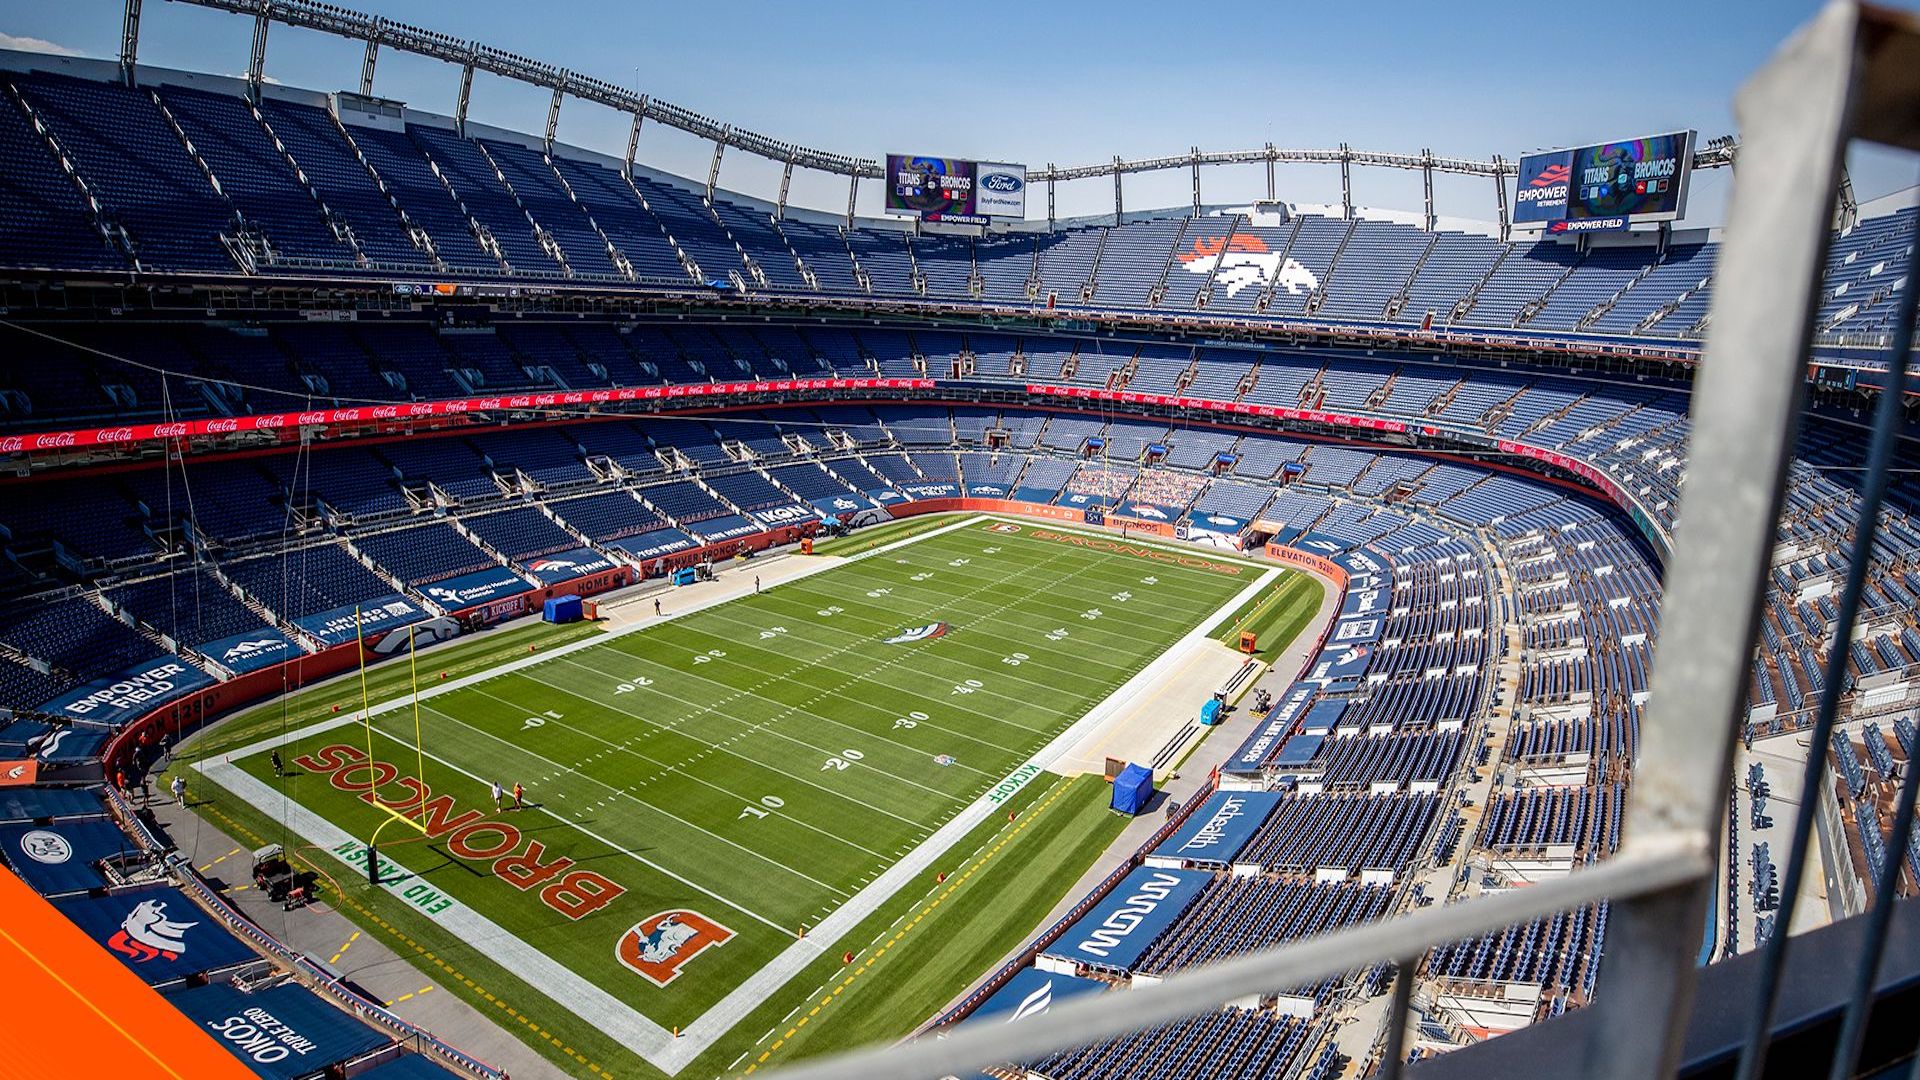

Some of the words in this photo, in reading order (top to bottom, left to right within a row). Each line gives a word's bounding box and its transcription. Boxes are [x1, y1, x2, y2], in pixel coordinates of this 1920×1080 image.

[1584, 166, 1609, 184] TITANS
[1634, 158, 1676, 179] BRONCOS
[898, 172, 920, 186] TITANS
[940, 175, 970, 190] BRONCOS
[987, 175, 1015, 191] Ford
[1518, 186, 1567, 202] EMPOWER
[941, 214, 970, 223] EMPOWER
[971, 216, 987, 224] FIELD
[1567, 220, 1602, 231] EMPOWER
[1602, 218, 1623, 229] FIELD
[906, 485, 955, 493] EMPOWER
[756, 505, 809, 522] IKON
[1113, 519, 1158, 532] BRONCOS
[637, 547, 660, 558] YOU
[659, 540, 690, 553] FRONT
[1030, 529, 1244, 575] BRONCOS
[1271, 548, 1317, 569] ELEVATION
[572, 559, 610, 575] THANK
[577, 576, 608, 593] HOME
[491, 599, 518, 616] KICKOFF
[319, 612, 389, 636] AIRLINES
[325, 608, 382, 627] UNITED
[265, 642, 289, 655] HIGH
[1001, 652, 1030, 666] 50
[65, 663, 187, 716] EMPOWER
[615, 675, 654, 694] 20
[956, 679, 984, 695] 40
[112, 679, 175, 711] FIELD
[524, 709, 564, 728] 10
[895, 711, 930, 729] 30
[826, 749, 864, 771] 20
[988, 763, 1040, 804] KICKOFF
[744, 796, 785, 820] 10
[292, 743, 629, 921] BRONCOS
[1183, 796, 1247, 849] uchealth
[403, 884, 453, 914] END
[1078, 873, 1181, 957] ARROW
[243, 1007, 283, 1030] ZERO
[208, 1016, 289, 1064] OIKOS
[269, 1024, 318, 1056] TRIPLE
